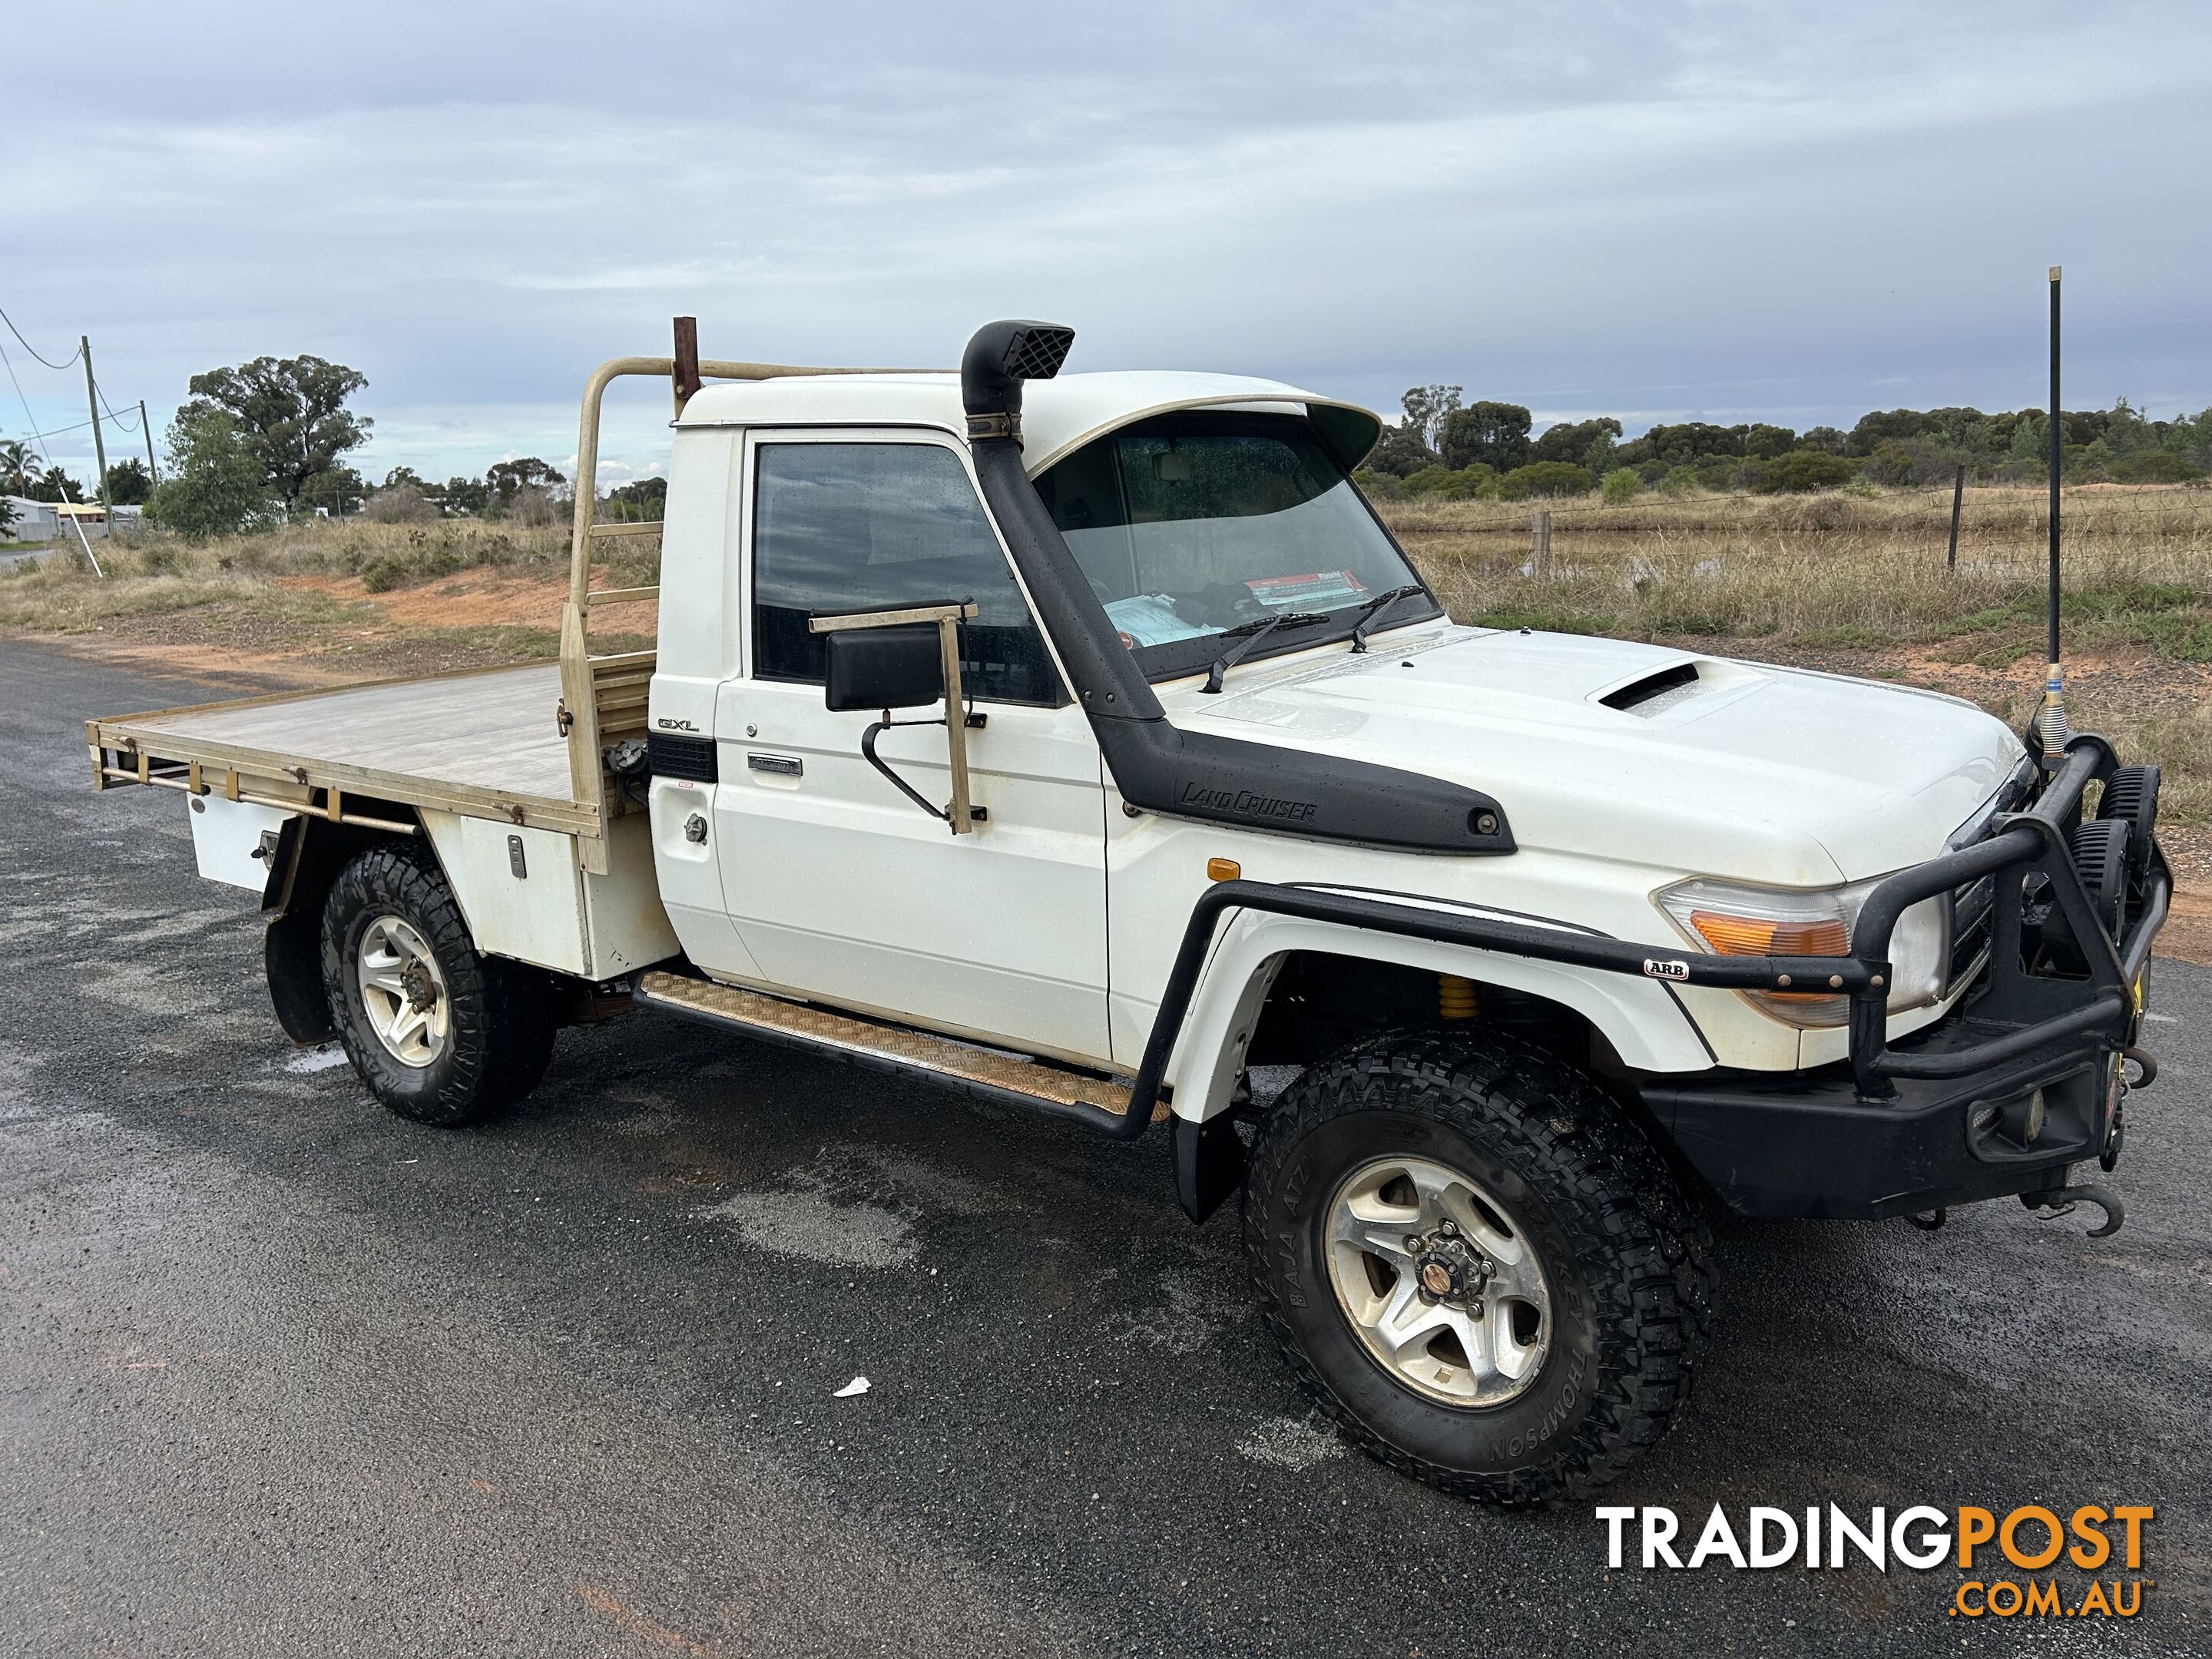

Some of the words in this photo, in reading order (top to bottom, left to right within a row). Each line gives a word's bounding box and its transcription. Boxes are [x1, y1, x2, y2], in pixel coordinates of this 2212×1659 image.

[657, 717, 700, 732] GXL
[1181, 782, 1233, 810] LAND
[1233, 790, 1319, 826] CRUISER
[1651, 962, 1684, 975] ARB
[1278, 1231, 1308, 1308] BAJA
[1512, 1195, 1588, 1335] MICKEY
[1488, 1344, 1588, 1462] THOMPSON
